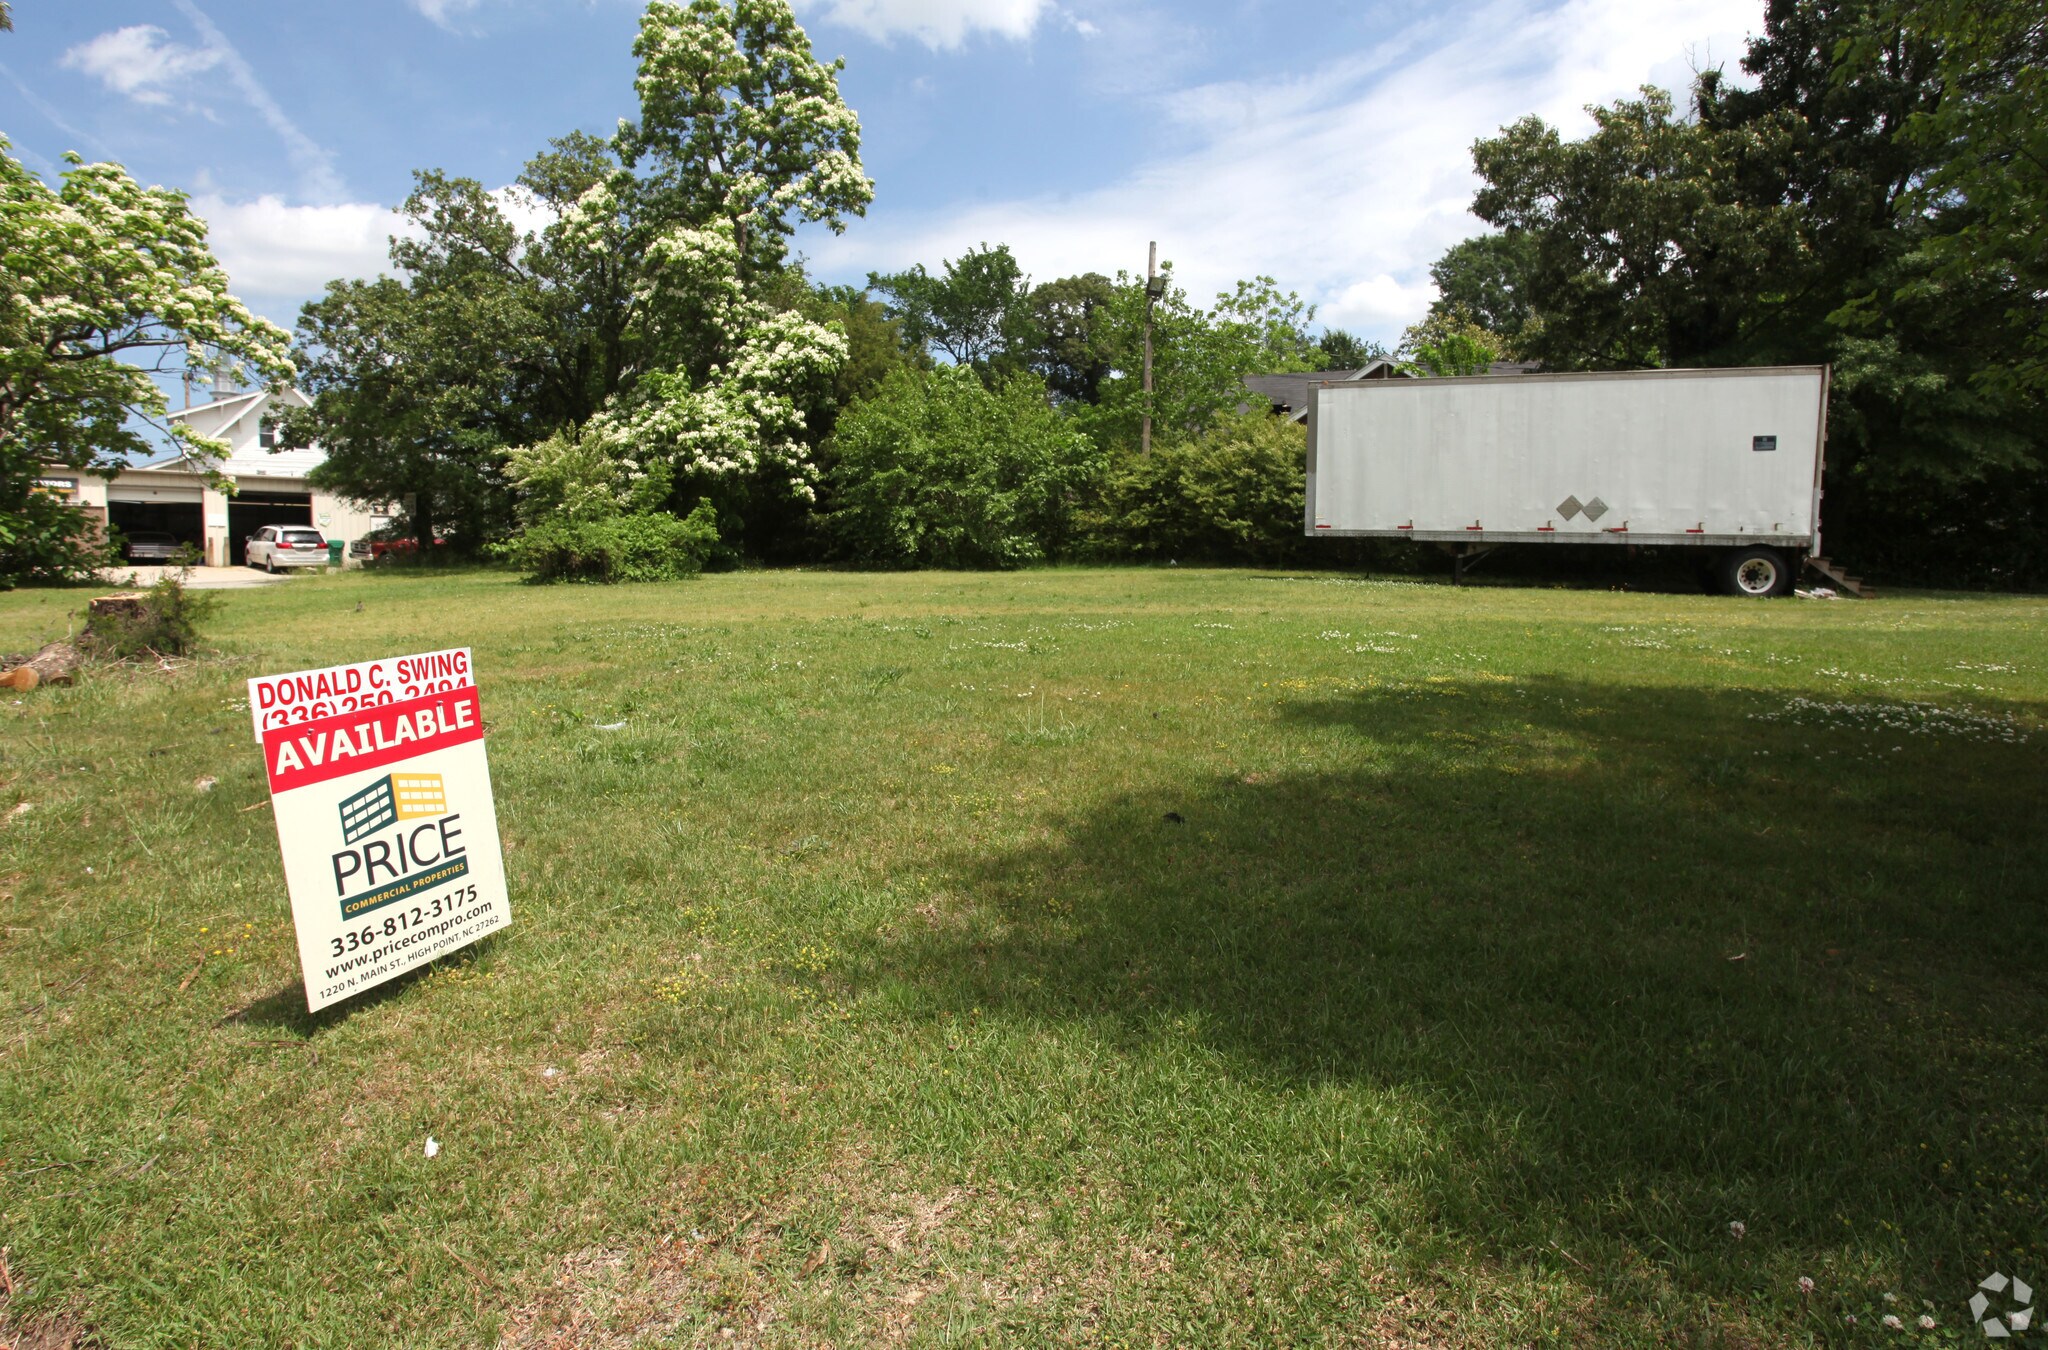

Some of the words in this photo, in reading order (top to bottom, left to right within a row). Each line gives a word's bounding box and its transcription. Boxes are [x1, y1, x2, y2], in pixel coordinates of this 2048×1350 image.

[257, 668, 361, 709] DONALD
[369, 664, 391, 689] C.
[397, 651, 468, 684] SWING
[275, 699, 474, 775] AVAILABLE
[331, 813, 466, 897] PRICE
[345, 885, 411, 913] COMMERCIAL
[412, 862, 465, 889] PROPERTIES
[319, 982, 345, 999] 1220
[347, 977, 359, 988] N.
[360, 963, 388, 983] MAIN
[407, 945, 432, 963] HIGH
[433, 932, 461, 951] POINT,
[462, 925, 474, 938] NC
[475, 915, 500, 932] 27262
[325, 901, 493, 979] www.pricecompro.com
[330, 884, 478, 958] 336-812-3175
